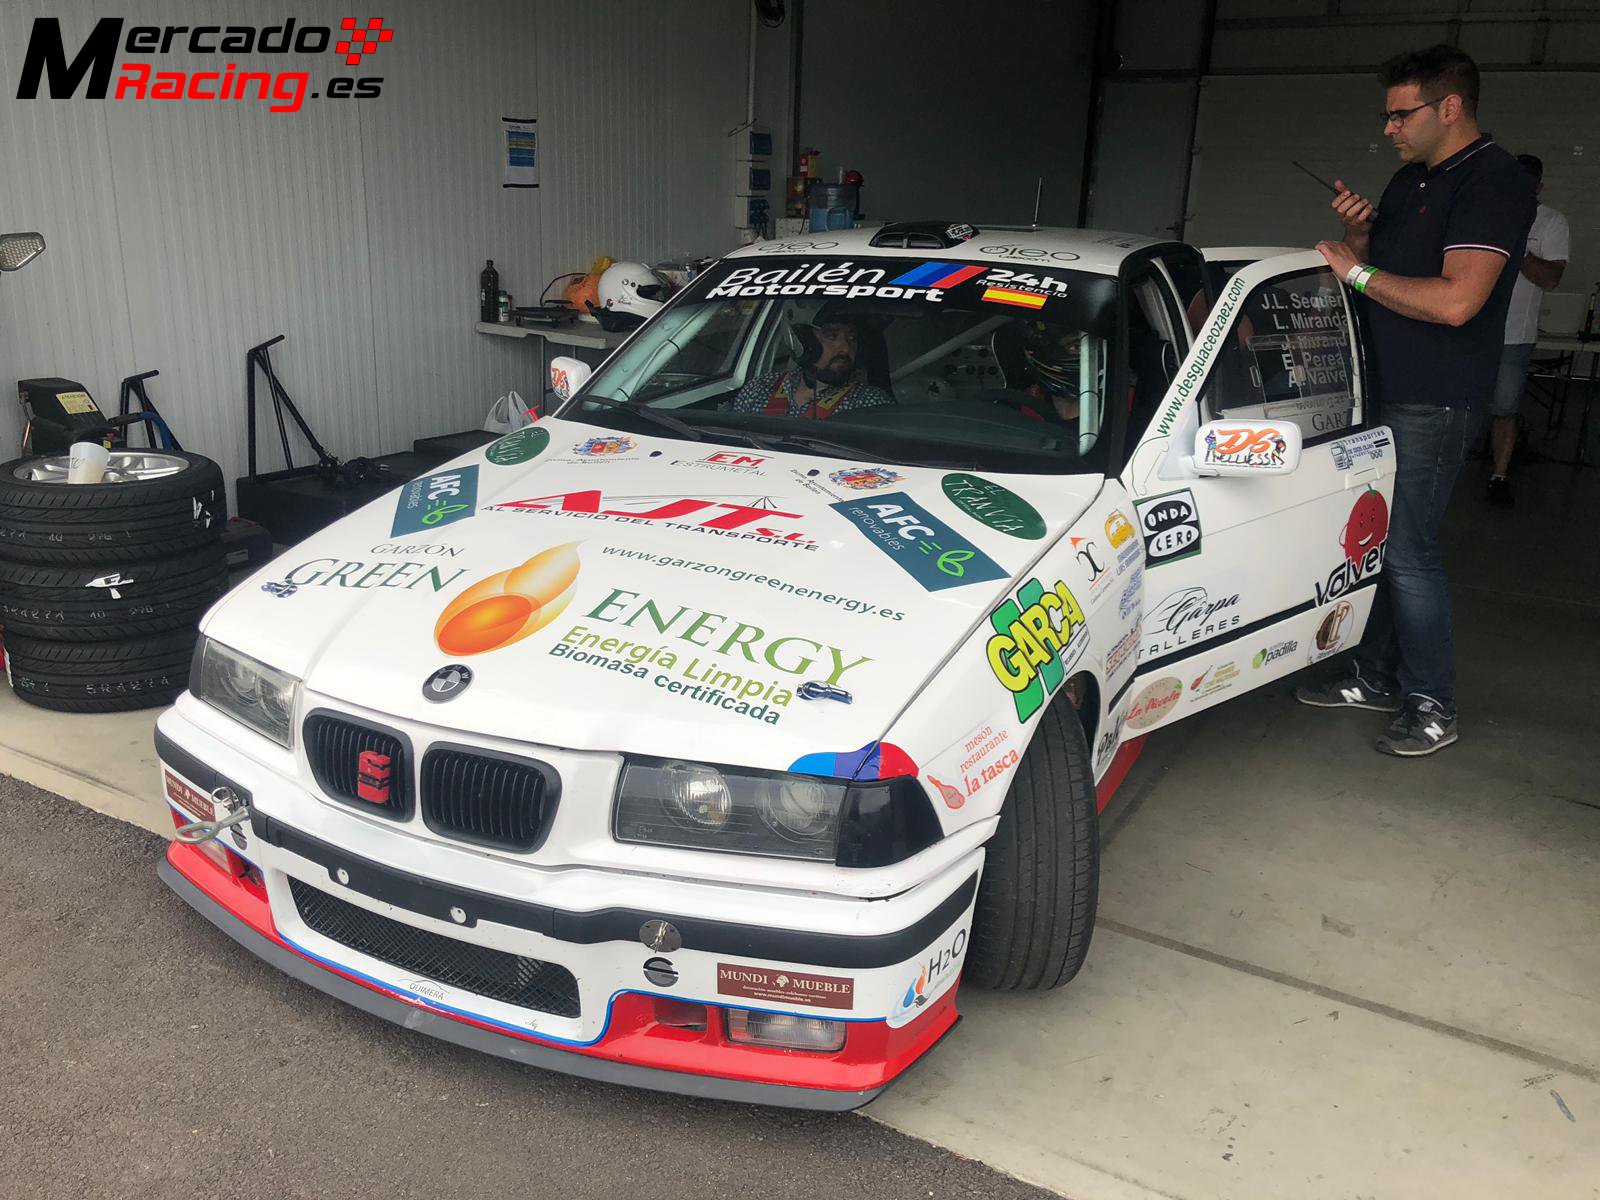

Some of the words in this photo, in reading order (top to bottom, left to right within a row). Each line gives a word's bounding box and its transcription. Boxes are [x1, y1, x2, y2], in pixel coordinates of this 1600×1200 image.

[718, 261, 887, 288] Bailén
[988, 268, 1069, 293] 24h
[705, 284, 944, 303] Motorsport
[976, 278, 1069, 299] Resistencia
[1261, 293, 1289, 310] J.L.
[1273, 313, 1290, 330] L.
[707, 453, 769, 469] EM
[427, 474, 462, 501] AFC
[512, 505, 608, 520] SERVICIO
[616, 516, 654, 527] DEL
[664, 522, 821, 552] TRANSPORTE
[849, 507, 905, 551] renovables
[867, 503, 935, 541] AFC
[1147, 505, 1189, 527] ONDA
[756, 526, 818, 545] S.L.
[1155, 530, 1194, 552] CERO
[602, 543, 905, 622] www.garzongreenenergy.es
[284, 558, 473, 593] GREEN
[581, 587, 877, 688] ENERGY
[985, 580, 1086, 693] GARCA
[1137, 614, 1241, 660] TALLERES
[562, 625, 677, 671] Energía
[682, 656, 794, 708] Limpia
[548, 642, 650, 680] Biomasa
[653, 671, 782, 726] certificada
[959, 729, 1010, 774] restaurante
[964, 726, 993, 753] mesón
[964, 776, 981, 798] la
[982, 749, 1020, 784] tasca
[927, 928, 967, 984] H2O
[409, 982, 444, 1000] QUIMERA
[719, 969, 768, 985] MUNDI
[792, 978, 851, 994] MUEBLE
